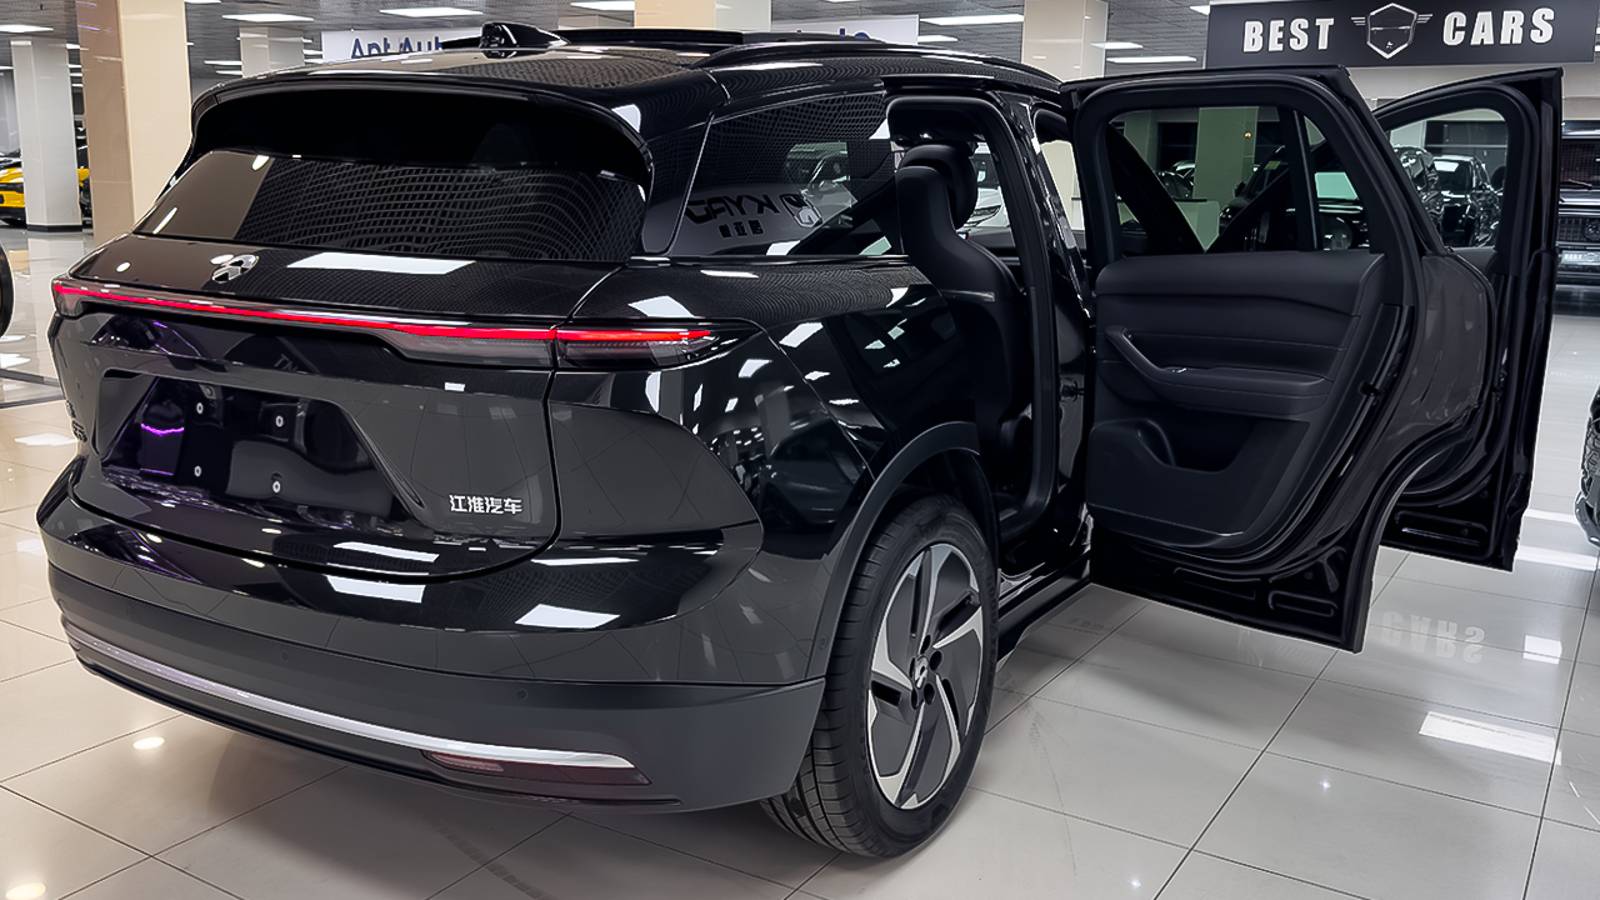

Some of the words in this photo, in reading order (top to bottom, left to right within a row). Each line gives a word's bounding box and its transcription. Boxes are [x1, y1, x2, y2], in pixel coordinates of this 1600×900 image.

[1243, 18, 1335, 53] BEST
[1443, 7, 1555, 46] CARS
[449, 494, 523, 515] 江淮汽车
